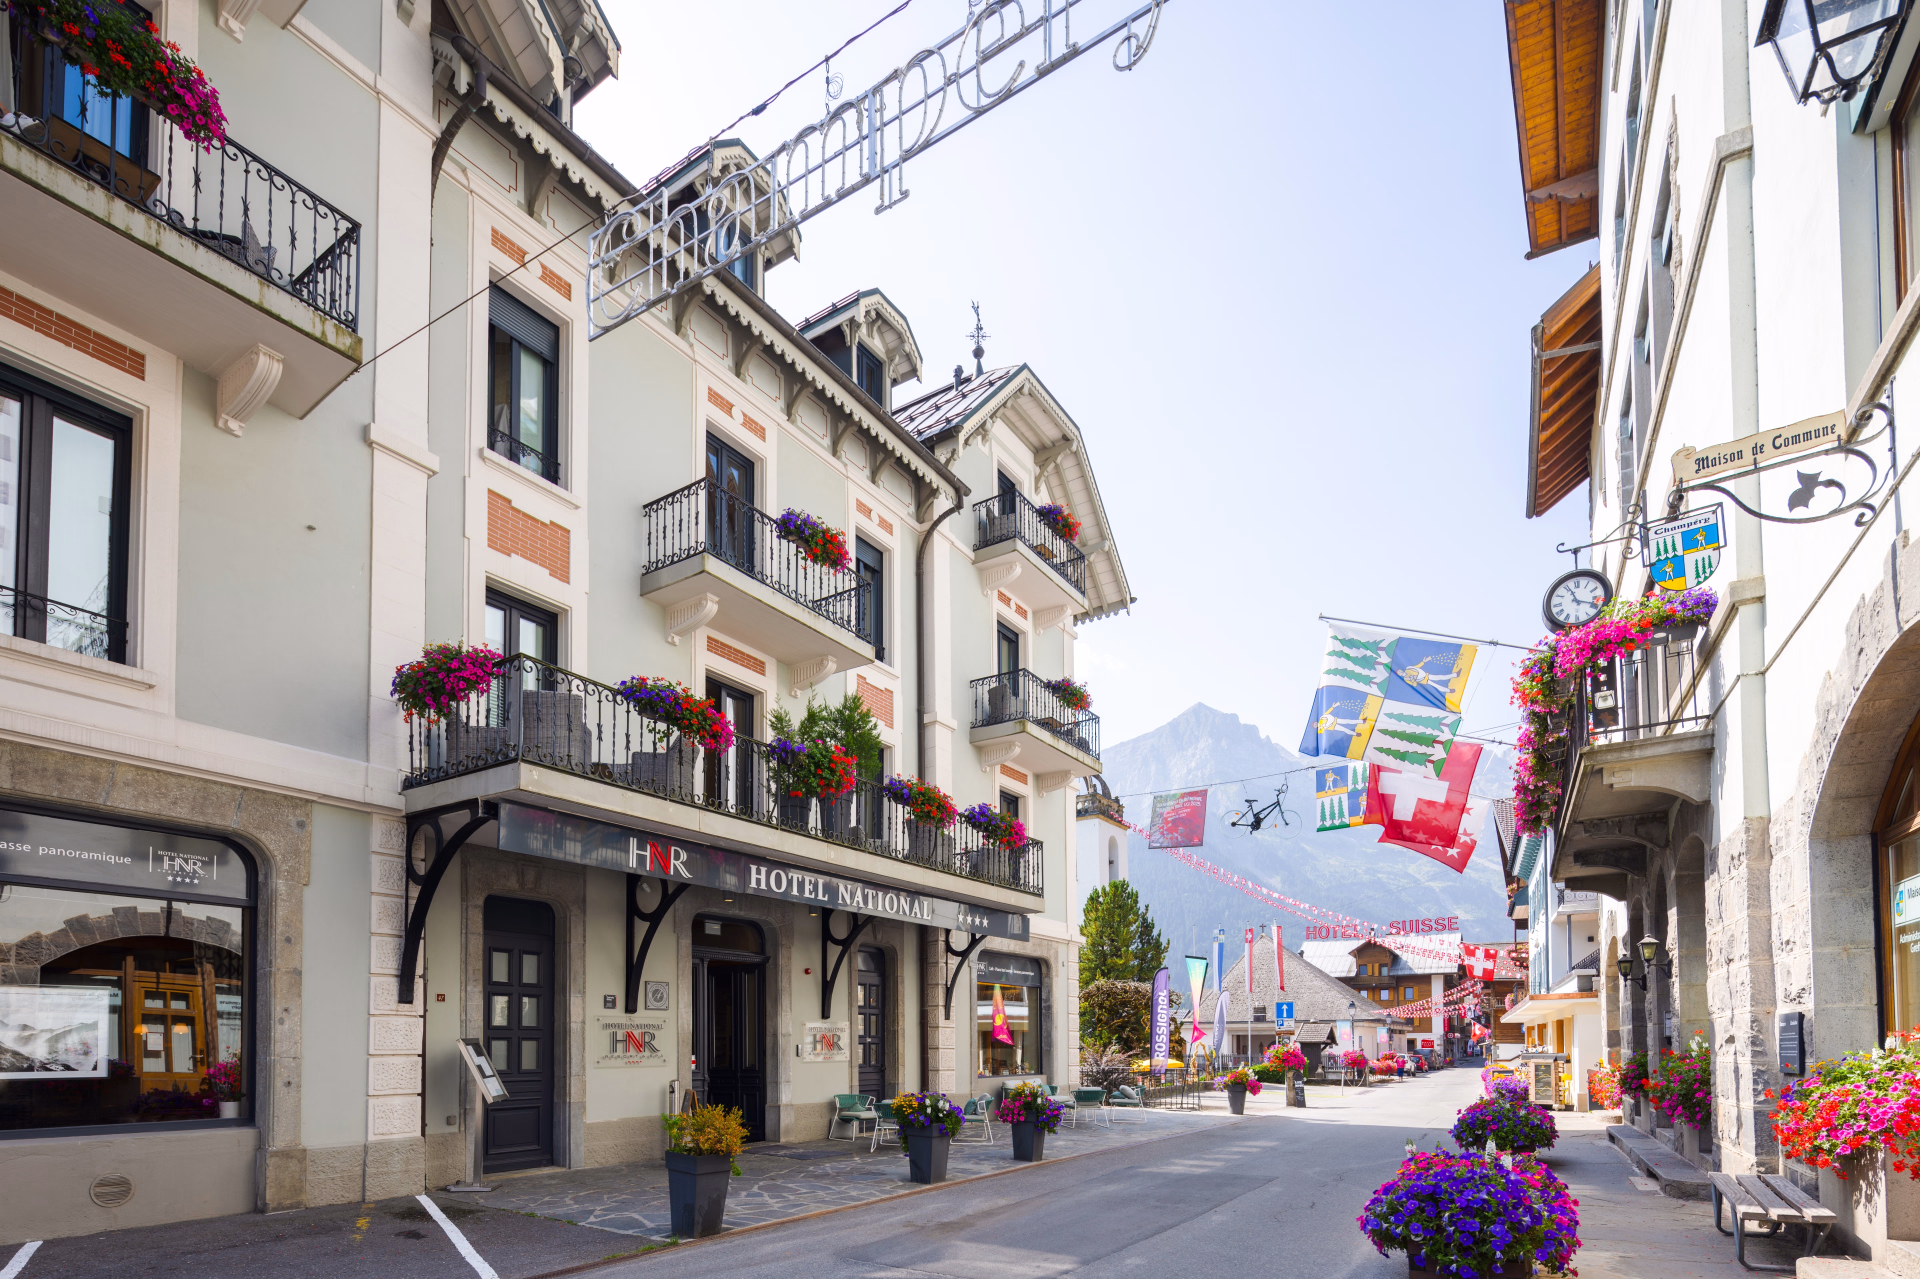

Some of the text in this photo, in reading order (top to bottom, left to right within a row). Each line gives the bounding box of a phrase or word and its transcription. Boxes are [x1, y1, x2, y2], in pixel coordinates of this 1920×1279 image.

[1694, 424, 1837, 474] Maison de Commune
[39, 846, 131, 864] panoramique
[164, 856, 205, 874] HNR
[629, 837, 692, 879] HNR
[750, 864, 932, 920] HOTEL NATIONAL
[1389, 916, 1459, 935] SUISSE
[1154, 990, 1168, 1060] ROSSIGNOL
[612, 1031, 660, 1053] HNR
[813, 1034, 844, 1051] HNR
